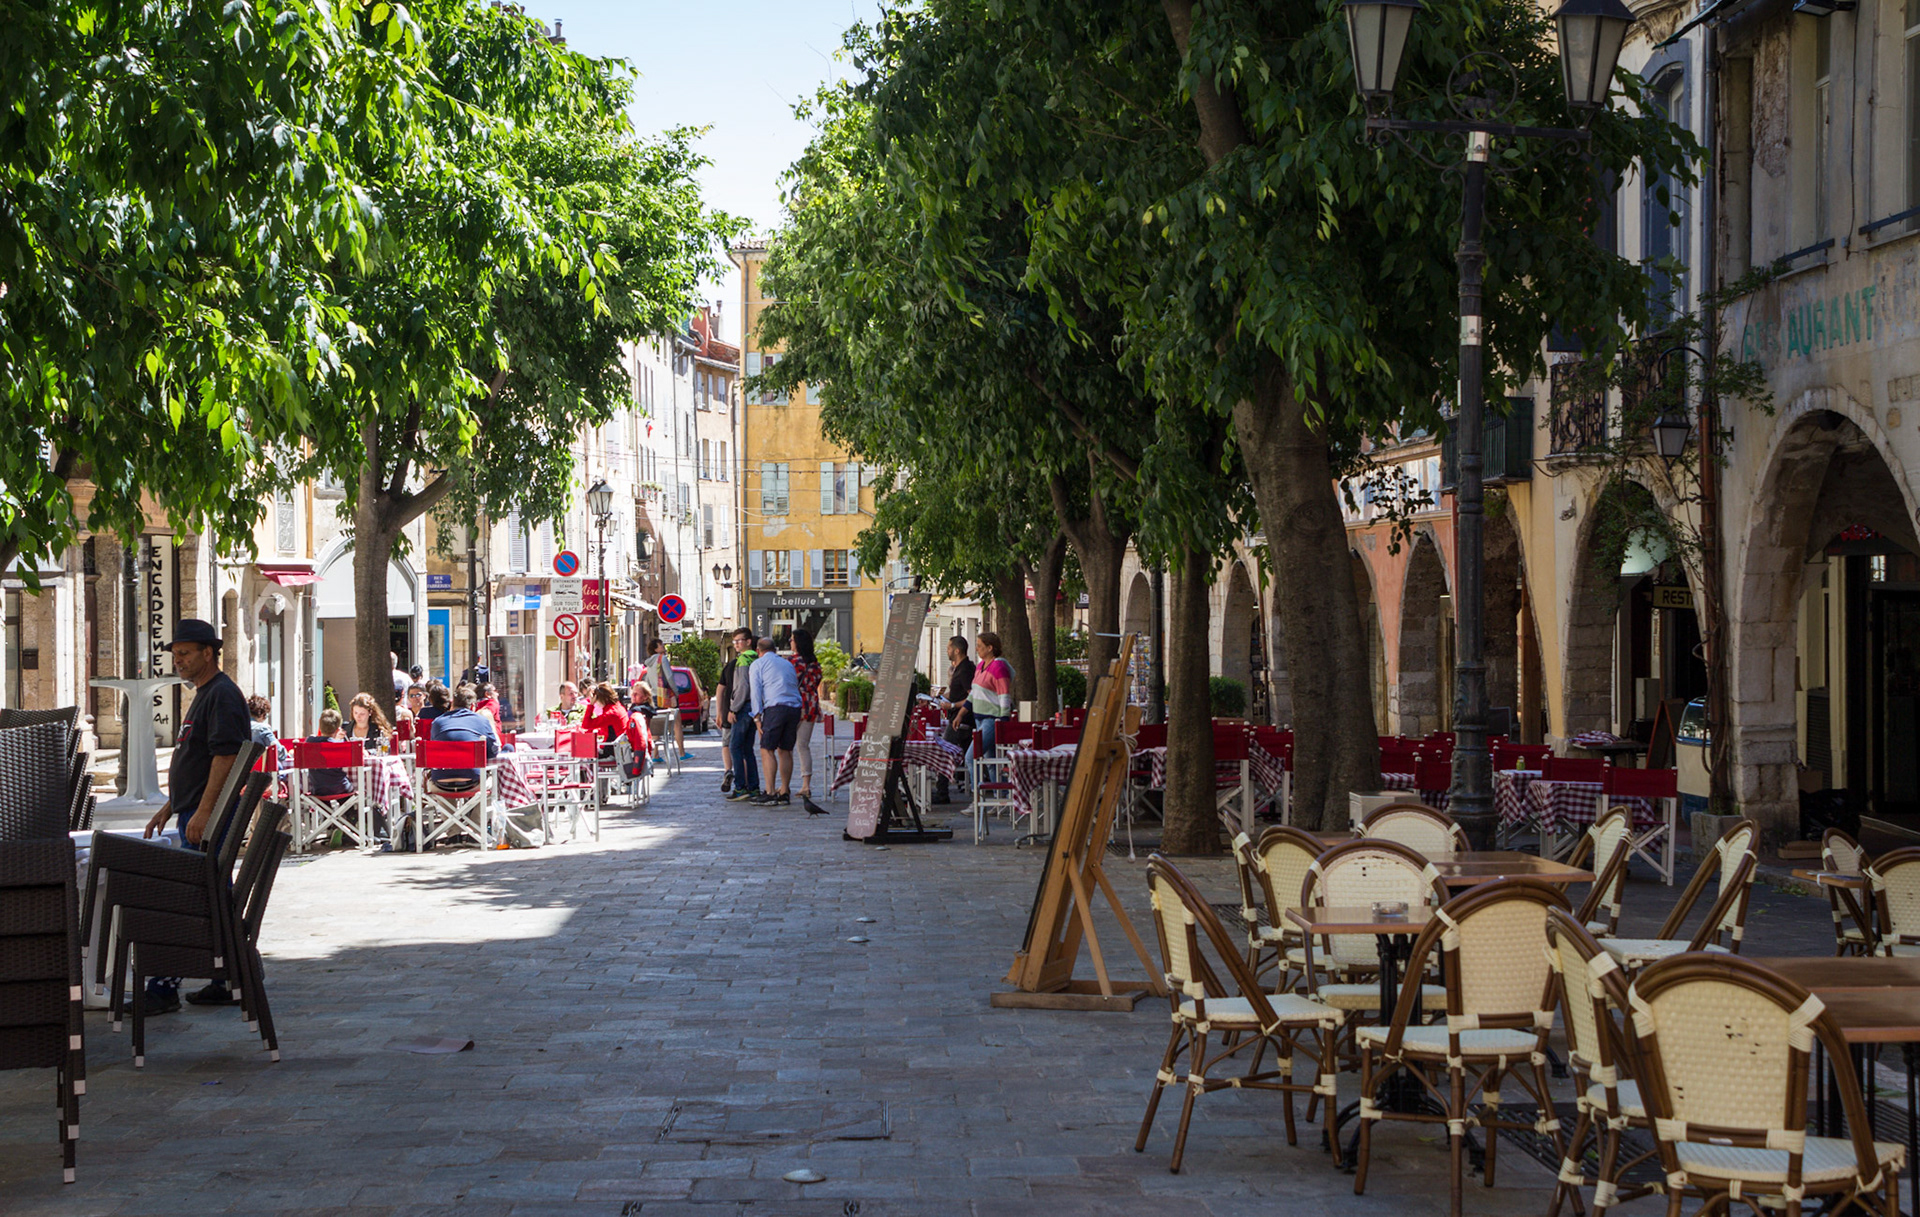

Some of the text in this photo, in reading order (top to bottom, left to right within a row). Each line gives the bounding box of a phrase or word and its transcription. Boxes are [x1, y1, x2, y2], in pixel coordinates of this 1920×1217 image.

[1744, 284, 1877, 363] RESAURANT
[772, 597, 817, 606] Libellule
[151, 545, 165, 707] ENCADREMENS
[153, 712, 169, 725] Art
